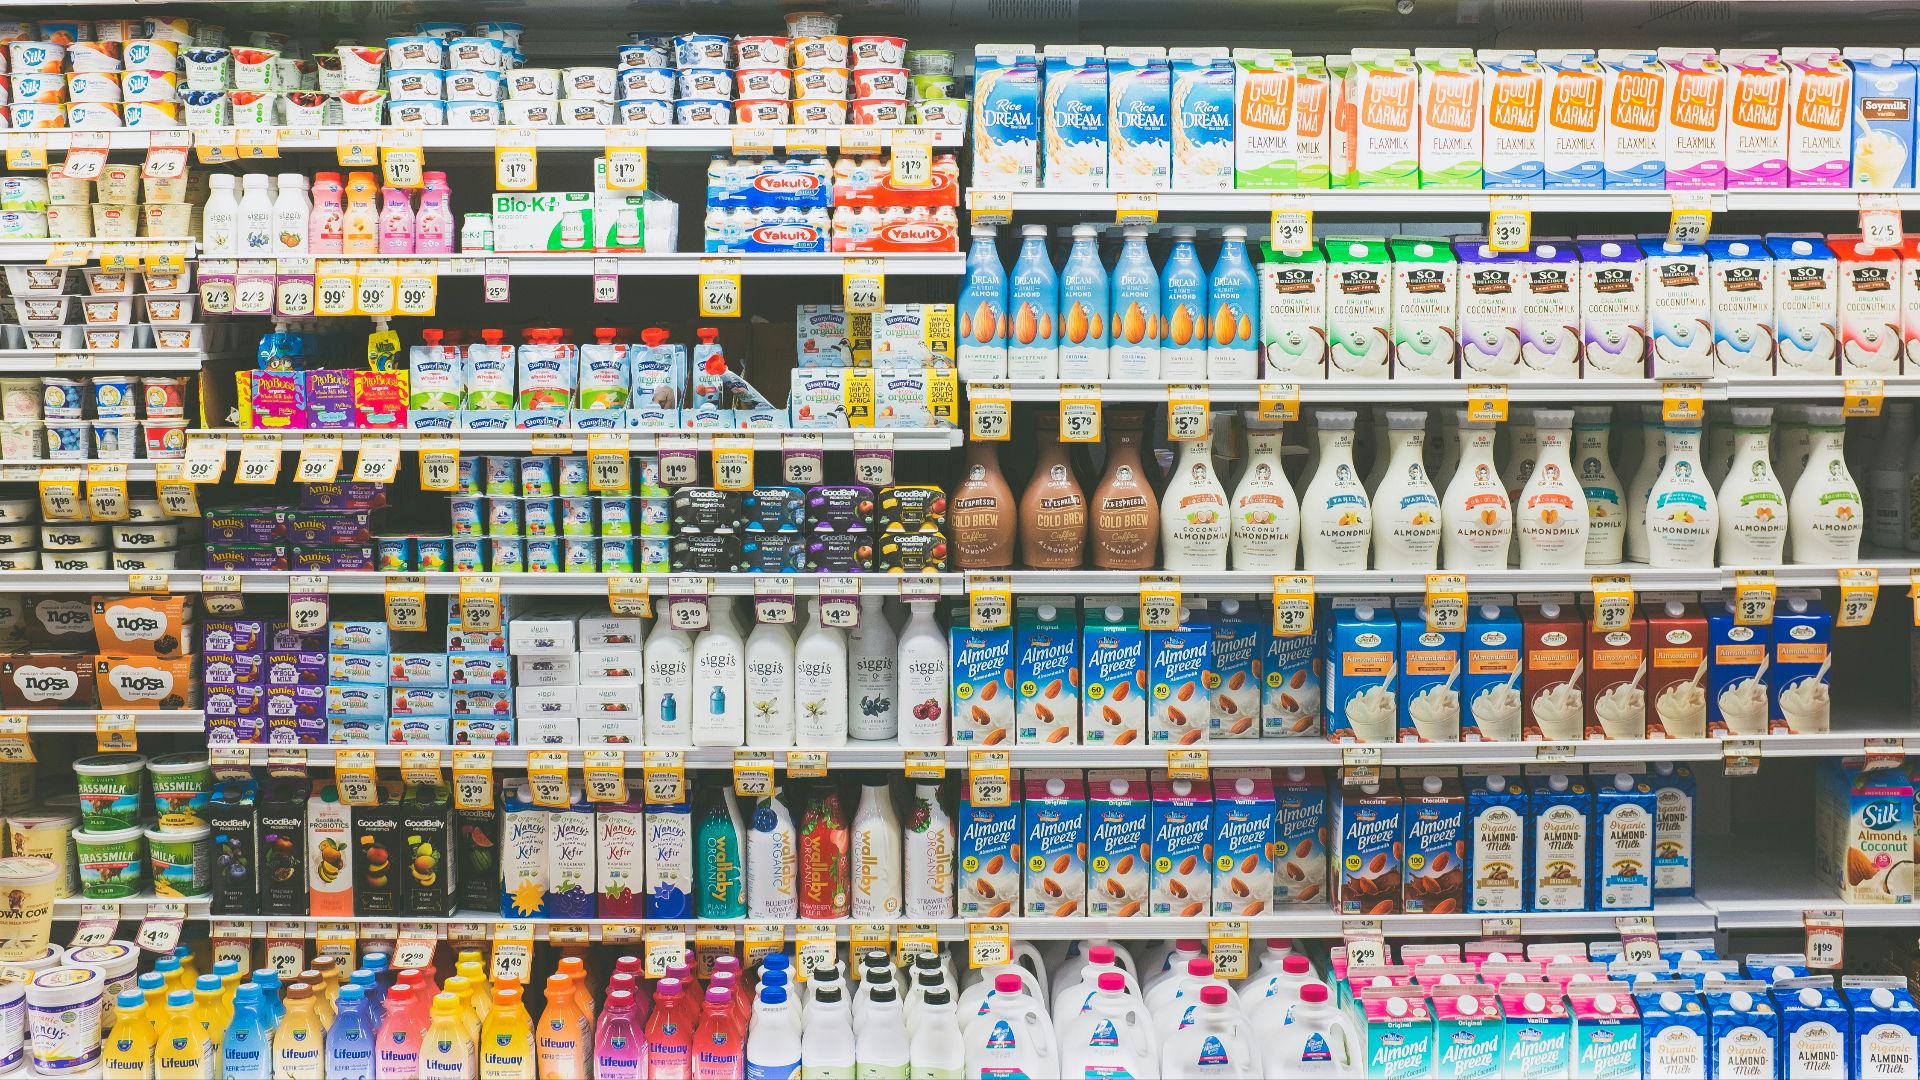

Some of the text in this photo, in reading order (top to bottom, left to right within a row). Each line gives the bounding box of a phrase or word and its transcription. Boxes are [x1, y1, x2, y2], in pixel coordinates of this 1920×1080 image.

[23, 47, 46, 66] Silk
[128, 75, 149, 94] Silk
[1249, 75, 1287, 103] GOOD
[1683, 76, 1719, 103] GOOD
[996, 101, 1022, 111] Rice
[1068, 101, 1093, 111] Rice
[1195, 101, 1219, 113] Rice
[1866, 101, 1907, 112] Soymilk
[1245, 105, 1288, 129] KARMA
[1677, 104, 1715, 126] KARMA
[1249, 135, 1287, 149] FLAXMILK
[1678, 137, 1715, 149] FLAXMILK
[765, 178, 808, 189] Yakult
[892, 228, 938, 240] Yakult
[1670, 264, 1688, 273] SO
[1861, 269, 1880, 278] SO
[972, 275, 999, 284] DREAM
[1285, 270, 1304, 280] SO
[1483, 271, 1501, 280] SO
[1270, 305, 1320, 314] COCONUTMILK
[1467, 306, 1517, 315] COCONUTMILK
[1782, 301, 1831, 310] COCONUTMILK
[418, 362, 451, 371] Stonyfield
[806, 381, 839, 390] Stonyfield
[806, 394, 841, 404] organic
[888, 393, 923, 403] organic
[415, 418, 451, 428] Stonyfield
[579, 419, 614, 428] Stonyfield
[310, 484, 342, 496] Annie's
[690, 491, 726, 499] GoodBelly
[822, 489, 859, 499] GoodBelly
[894, 490, 931, 499] GoodBelly
[212, 519, 244, 529] Annie's
[952, 515, 998, 527] COLD BREW
[1038, 514, 1083, 527] COLD BREW
[1100, 514, 1148, 527] COLD BREW
[1523, 527, 1579, 535] ALMONDMILK
[1653, 526, 1710, 534] ALMONDMILK
[50, 533, 80, 544] noosa
[962, 531, 986, 541] Coffee
[55, 559, 88, 569] noosa
[48, 610, 90, 623] noosa
[117, 617, 158, 631] noosa
[207, 654, 233, 664] Annie's
[958, 641, 1008, 666] Almond
[269, 655, 297, 664] Annie's
[969, 655, 1004, 673] Breeze
[1100, 654, 1137, 673] Breeze
[1166, 657, 1201, 673] Breeze
[651, 661, 686, 676] siggi's
[857, 659, 892, 673] siggi's
[910, 661, 944, 675] siggi's
[121, 676, 165, 690] noosa
[1866, 803, 1900, 827] Silk
[263, 818, 301, 827] GoodBelly
[358, 820, 397, 829] GoodBelly
[1347, 815, 1398, 840] Almond
[1481, 822, 1517, 833] Organic
[514, 823, 546, 837] Nancy's
[604, 823, 637, 837] Nancy's
[964, 817, 1016, 840] Almond
[1358, 828, 1393, 845] Breeze
[1858, 831, 1900, 842] Almond
[1487, 840, 1511, 851] Milk
[1861, 841, 1908, 852] Coconut
[520, 847, 541, 858] Kefir
[658, 847, 679, 858] Kefir
[862, 830, 878, 896] wallaby
[715, 836, 732, 902] wallaby
[540, 1037, 575, 1049] Lifeway
[1582, 1035, 1637, 1061] Almond
[1798, 1041, 1834, 1052] Organic
[282, 1048, 318, 1060] Lifeway
[106, 1060, 144, 1071] Lifeway
[427, 1060, 462, 1071] Lifeway
[1804, 1061, 1830, 1071] Milk
